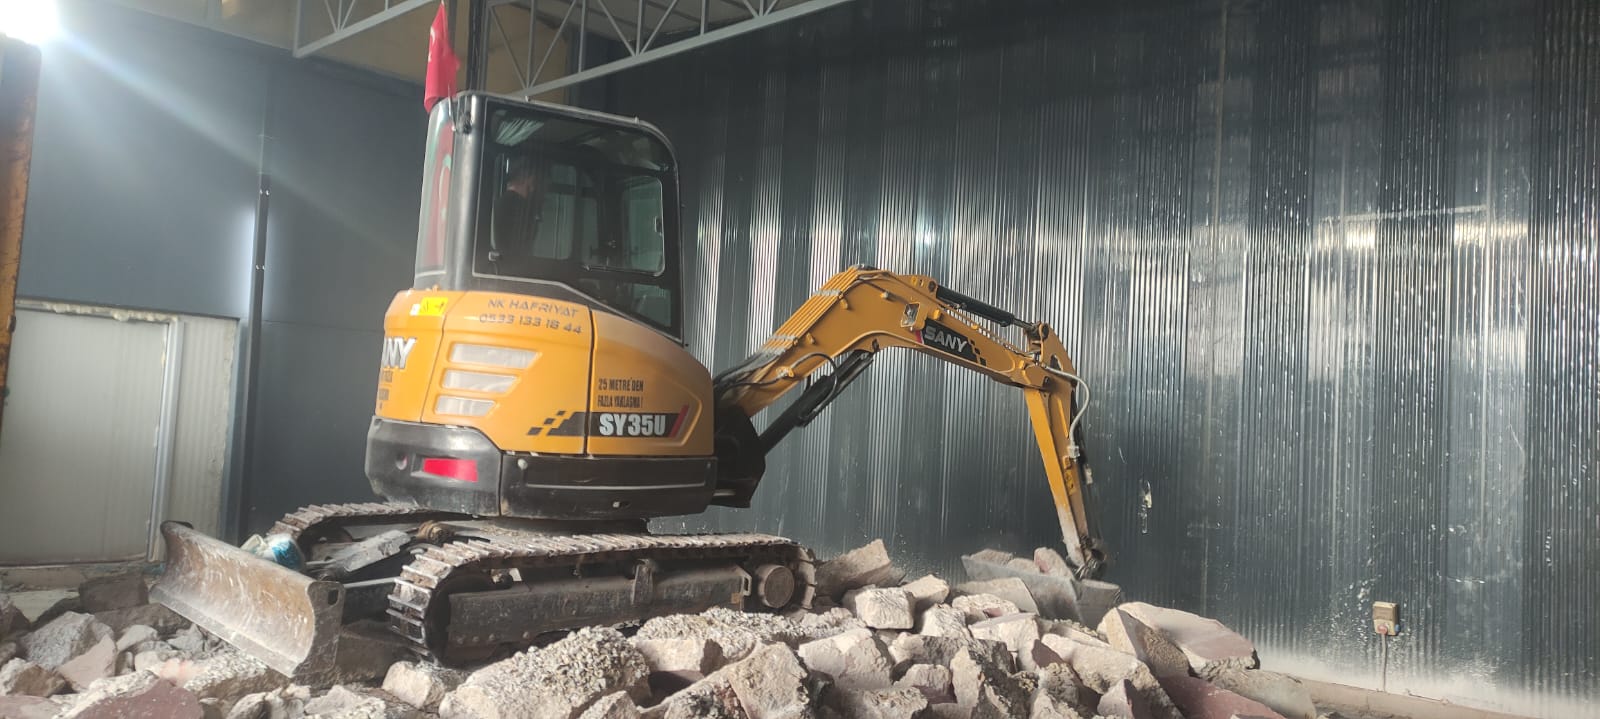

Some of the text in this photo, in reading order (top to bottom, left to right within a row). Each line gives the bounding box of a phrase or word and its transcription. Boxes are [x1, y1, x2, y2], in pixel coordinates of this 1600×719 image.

[510, 299, 578, 318] HAFRIYAT
[519, 316, 542, 327] 133
[563, 323, 582, 334] 44
[924, 325, 967, 353] SANY
[599, 378, 608, 391] 25
[599, 413, 666, 436] SY35U
